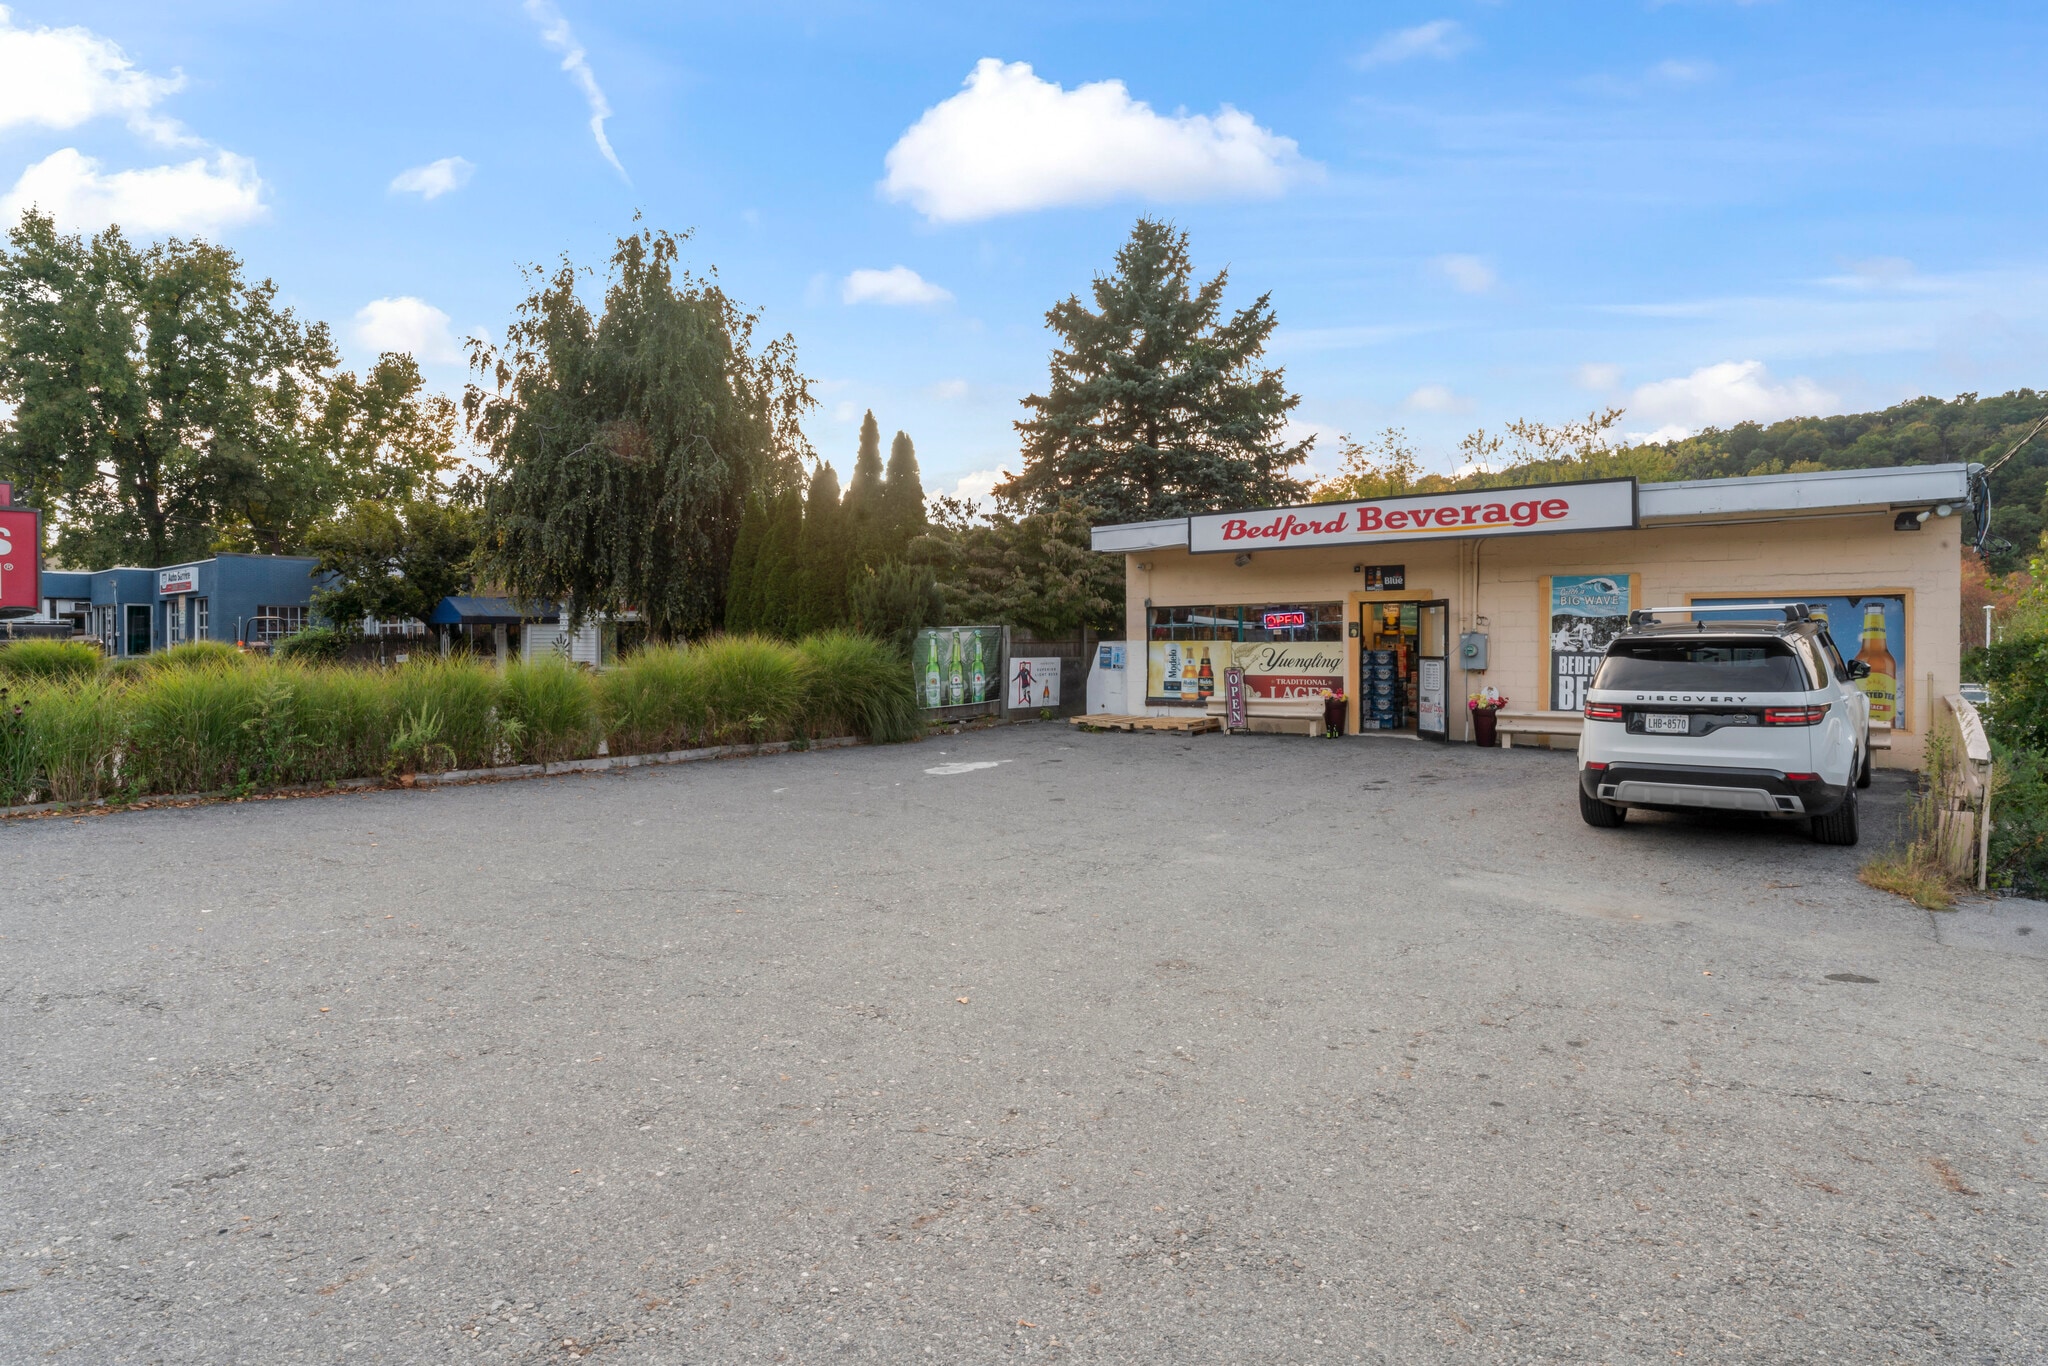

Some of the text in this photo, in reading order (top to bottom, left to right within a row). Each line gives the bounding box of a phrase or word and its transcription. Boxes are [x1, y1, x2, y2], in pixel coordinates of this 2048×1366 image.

[1221, 499, 1569, 541] Bedford Beverage
[168, 573, 177, 582] Auto
[1384, 576, 1403, 585] Blue
[1560, 595, 1619, 606] BIG WAVE
[1266, 614, 1303, 627] OPEN
[1168, 649, 1177, 678] Modelo
[1259, 647, 1343, 673] Yuengling
[1558, 655, 1603, 675] BEDFO
[1276, 678, 1327, 686] TRADITIONAL
[1229, 673, 1241, 722] OPEN
[1636, 695, 1747, 703] DISCOVERY
